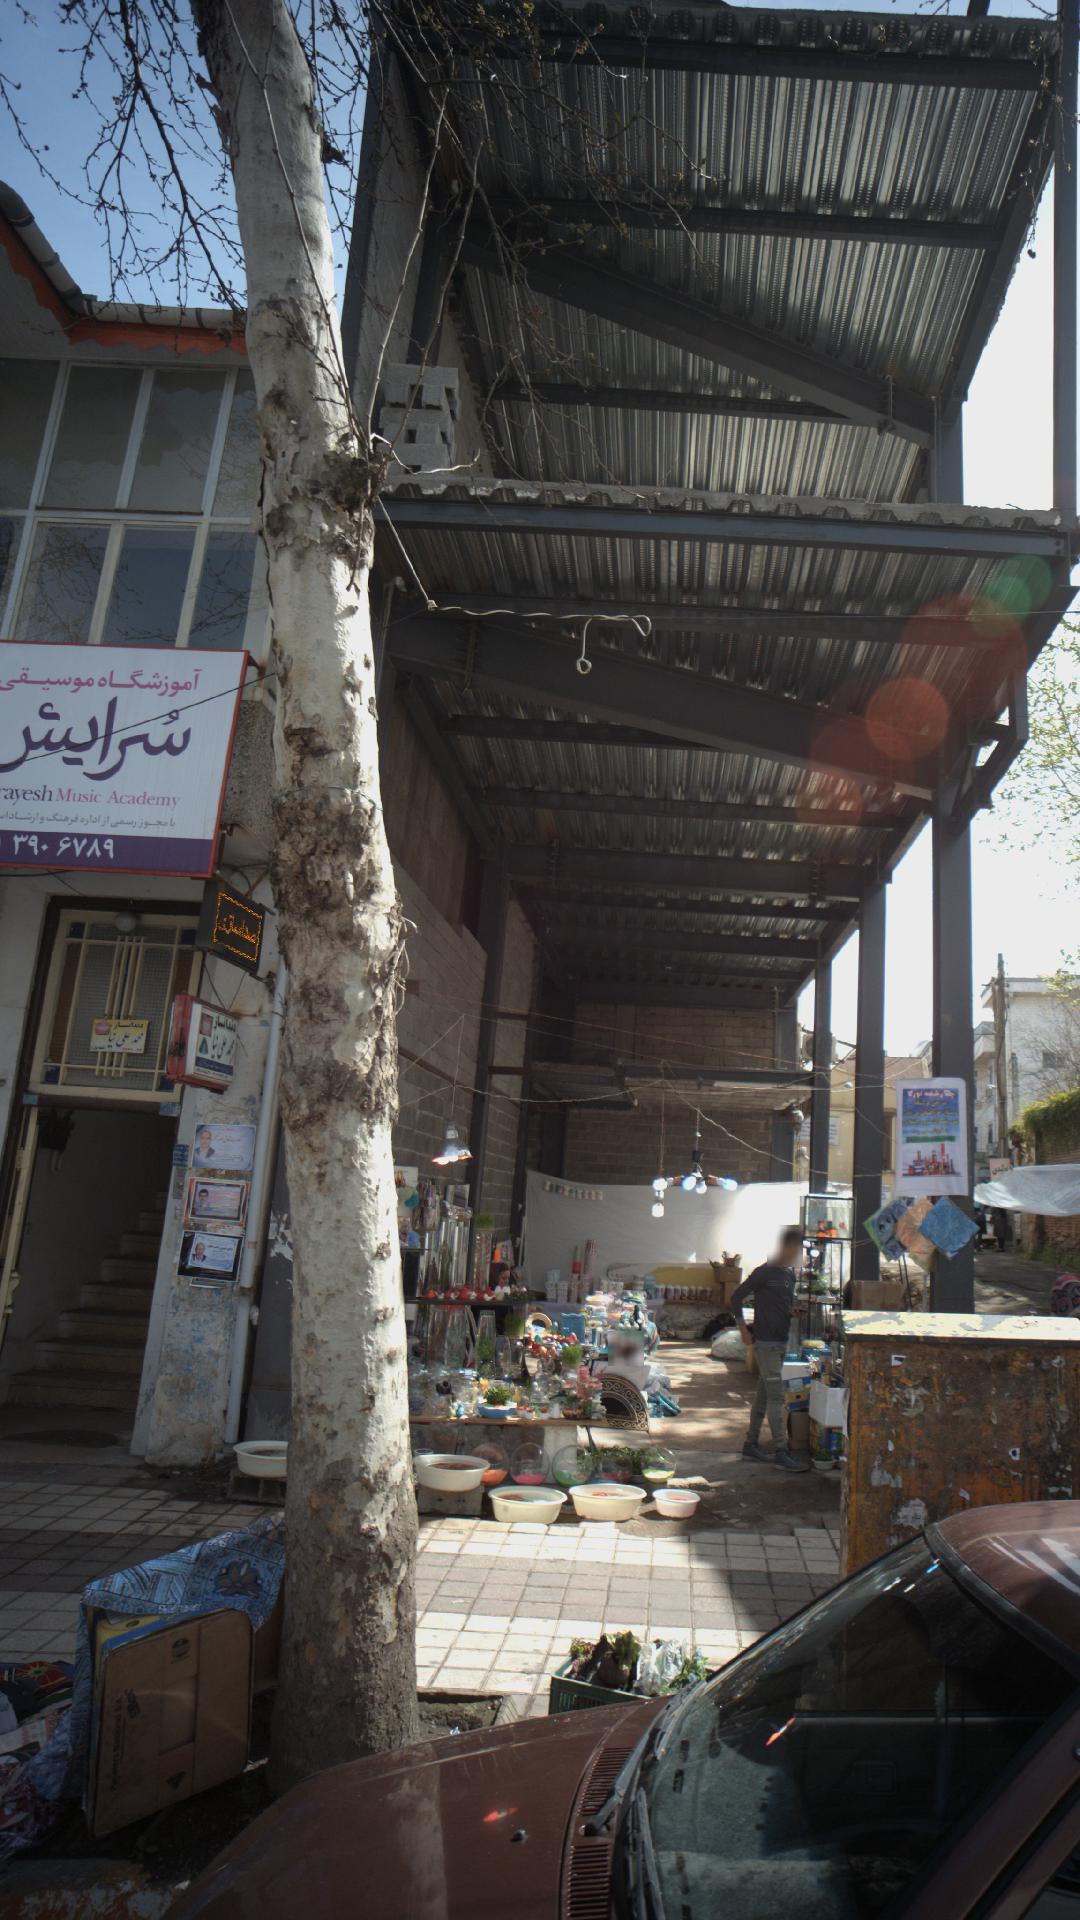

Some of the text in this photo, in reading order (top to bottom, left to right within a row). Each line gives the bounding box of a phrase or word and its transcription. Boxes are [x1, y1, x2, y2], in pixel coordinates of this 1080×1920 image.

[0, 667, 203, 697] آموزشگاه موسیقی
[56, 787, 102, 804] Music
[106, 790, 181, 809] Academy
[45, 812, 78, 826] فرهنگ
[79, 814, 100, 826] اداره
[101, 816, 110, 828] از
[110, 817, 137, 828] رسمی
[138, 816, 168, 829] مجوز
[13, 834, 115, 860] ۳۹۰ ۶۷۸۹
